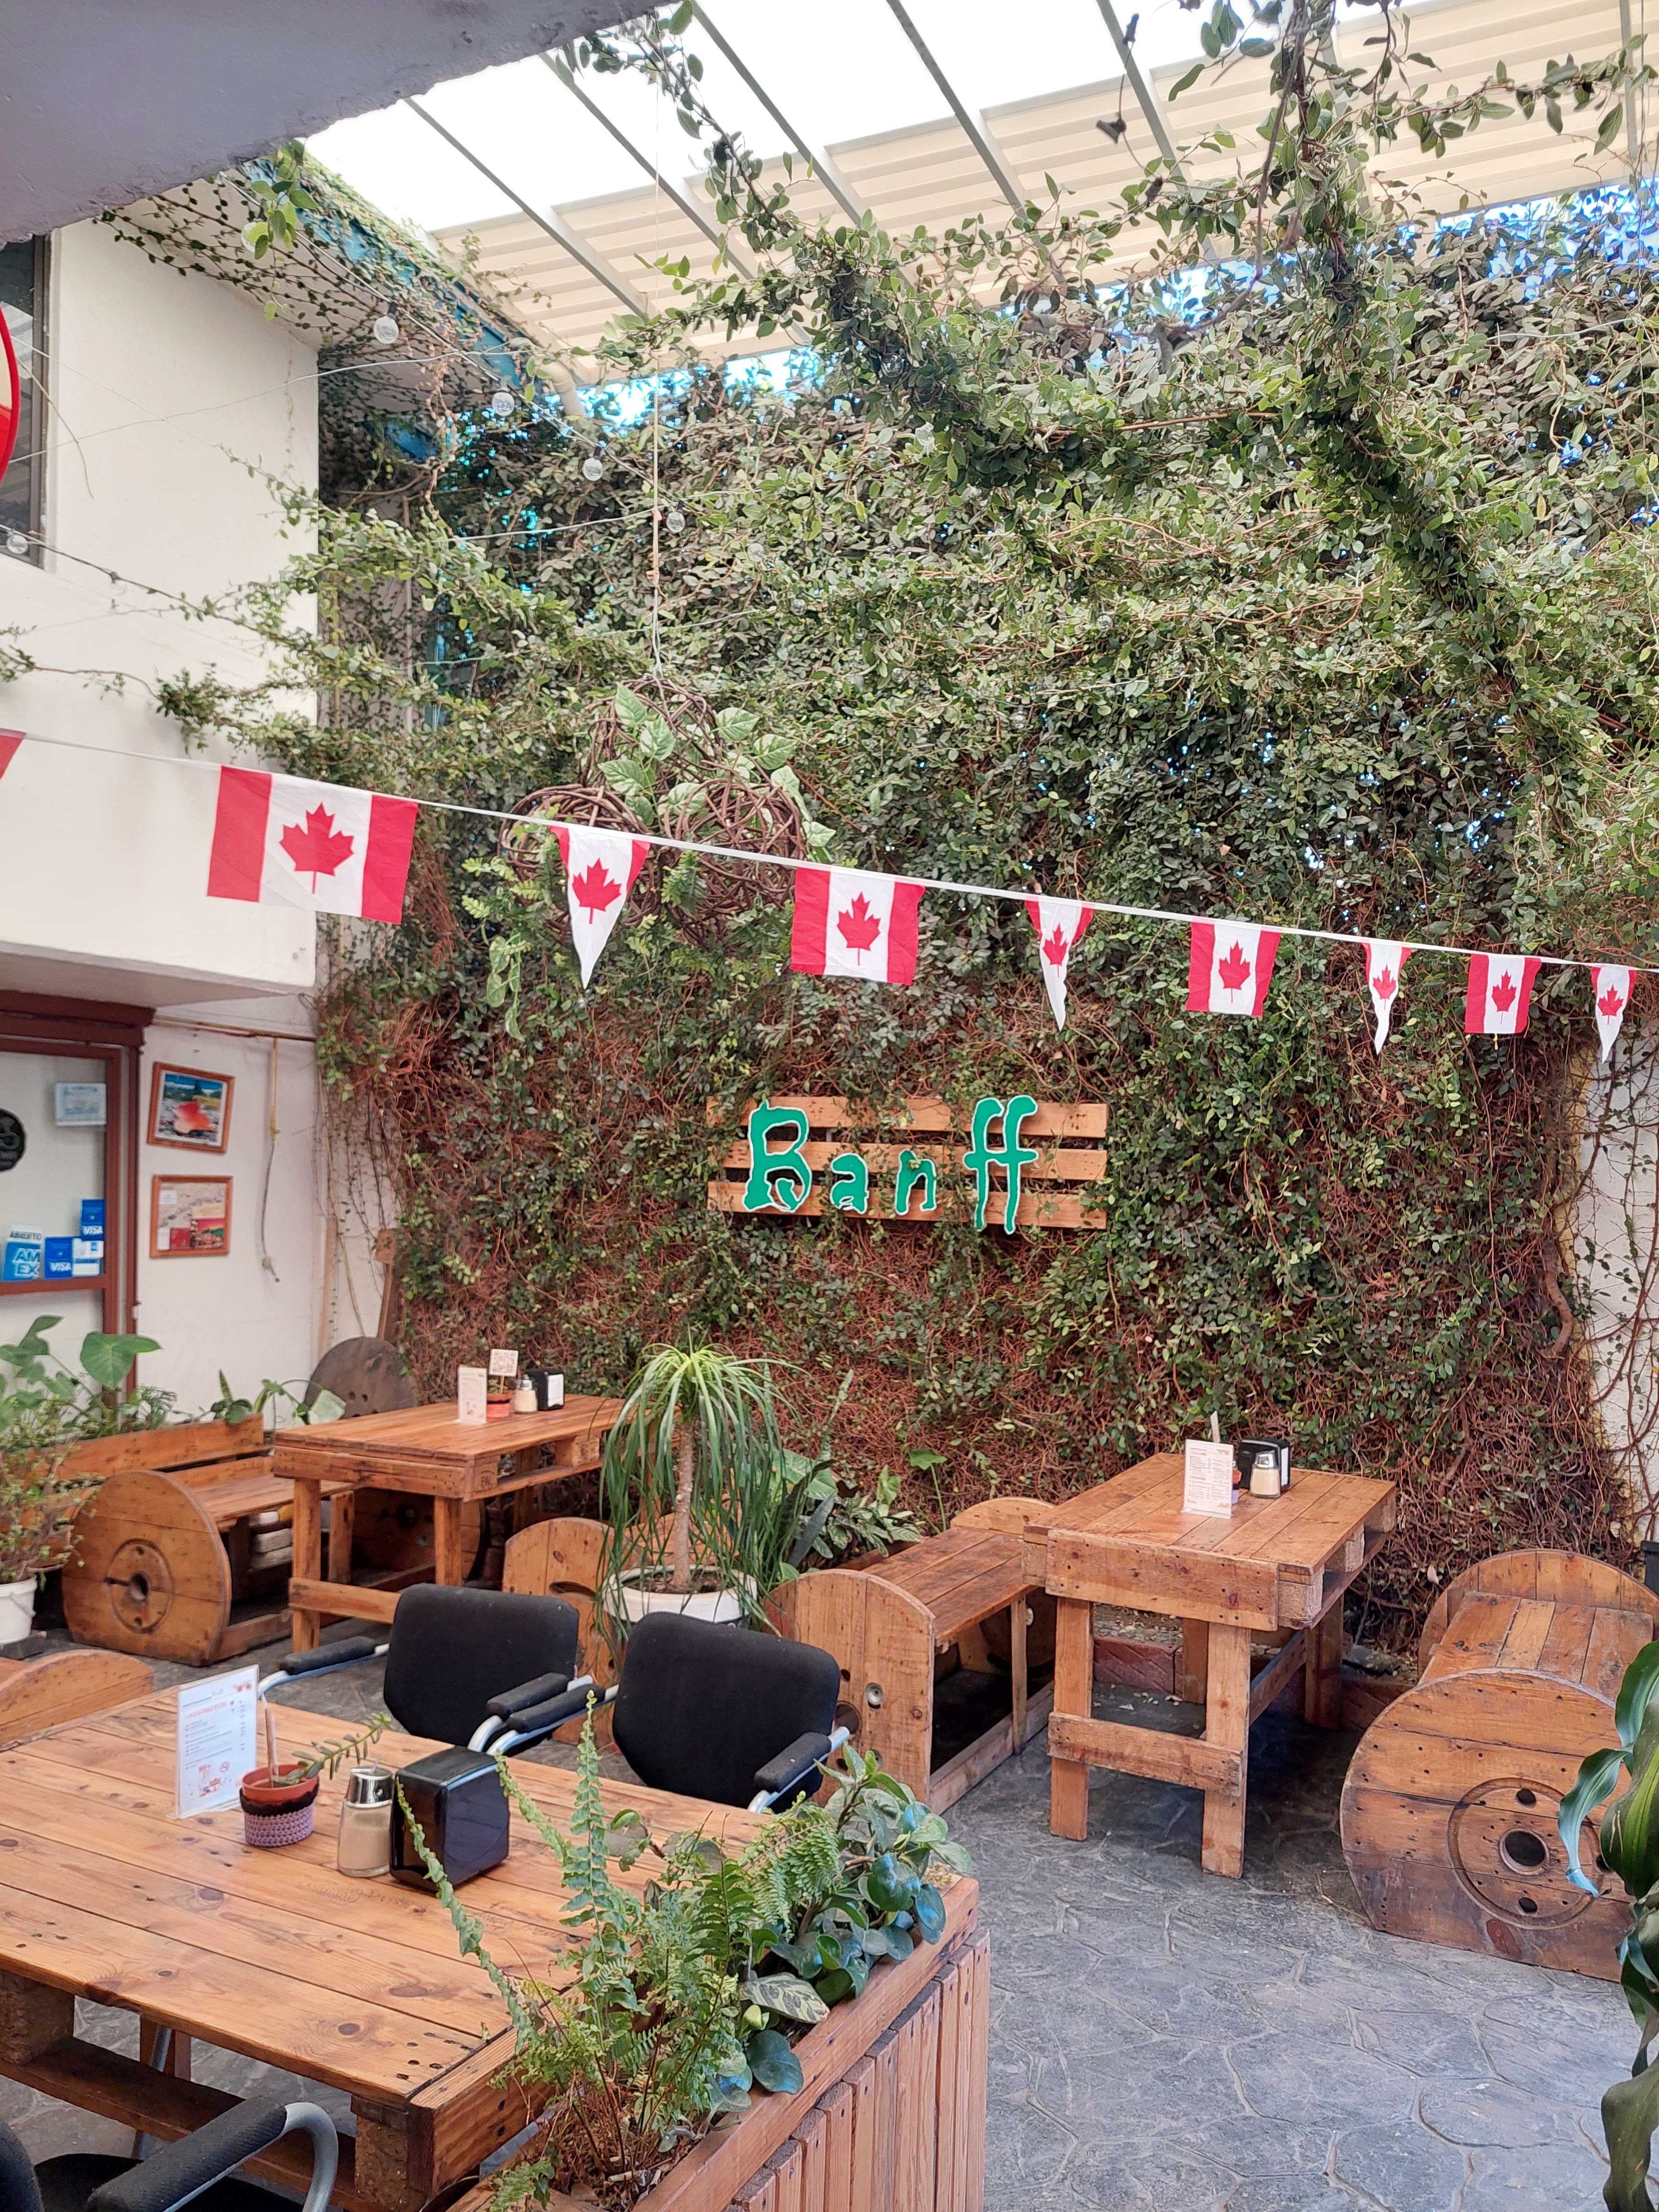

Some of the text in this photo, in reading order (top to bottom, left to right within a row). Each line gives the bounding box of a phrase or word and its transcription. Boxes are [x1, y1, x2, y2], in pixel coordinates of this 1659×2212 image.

[742, 1095, 1040, 1235] Banff
[82, 1226, 103, 1235] VISA
[13, 1248, 40, 1262] AM
[49, 1262, 72, 1272] VISA
